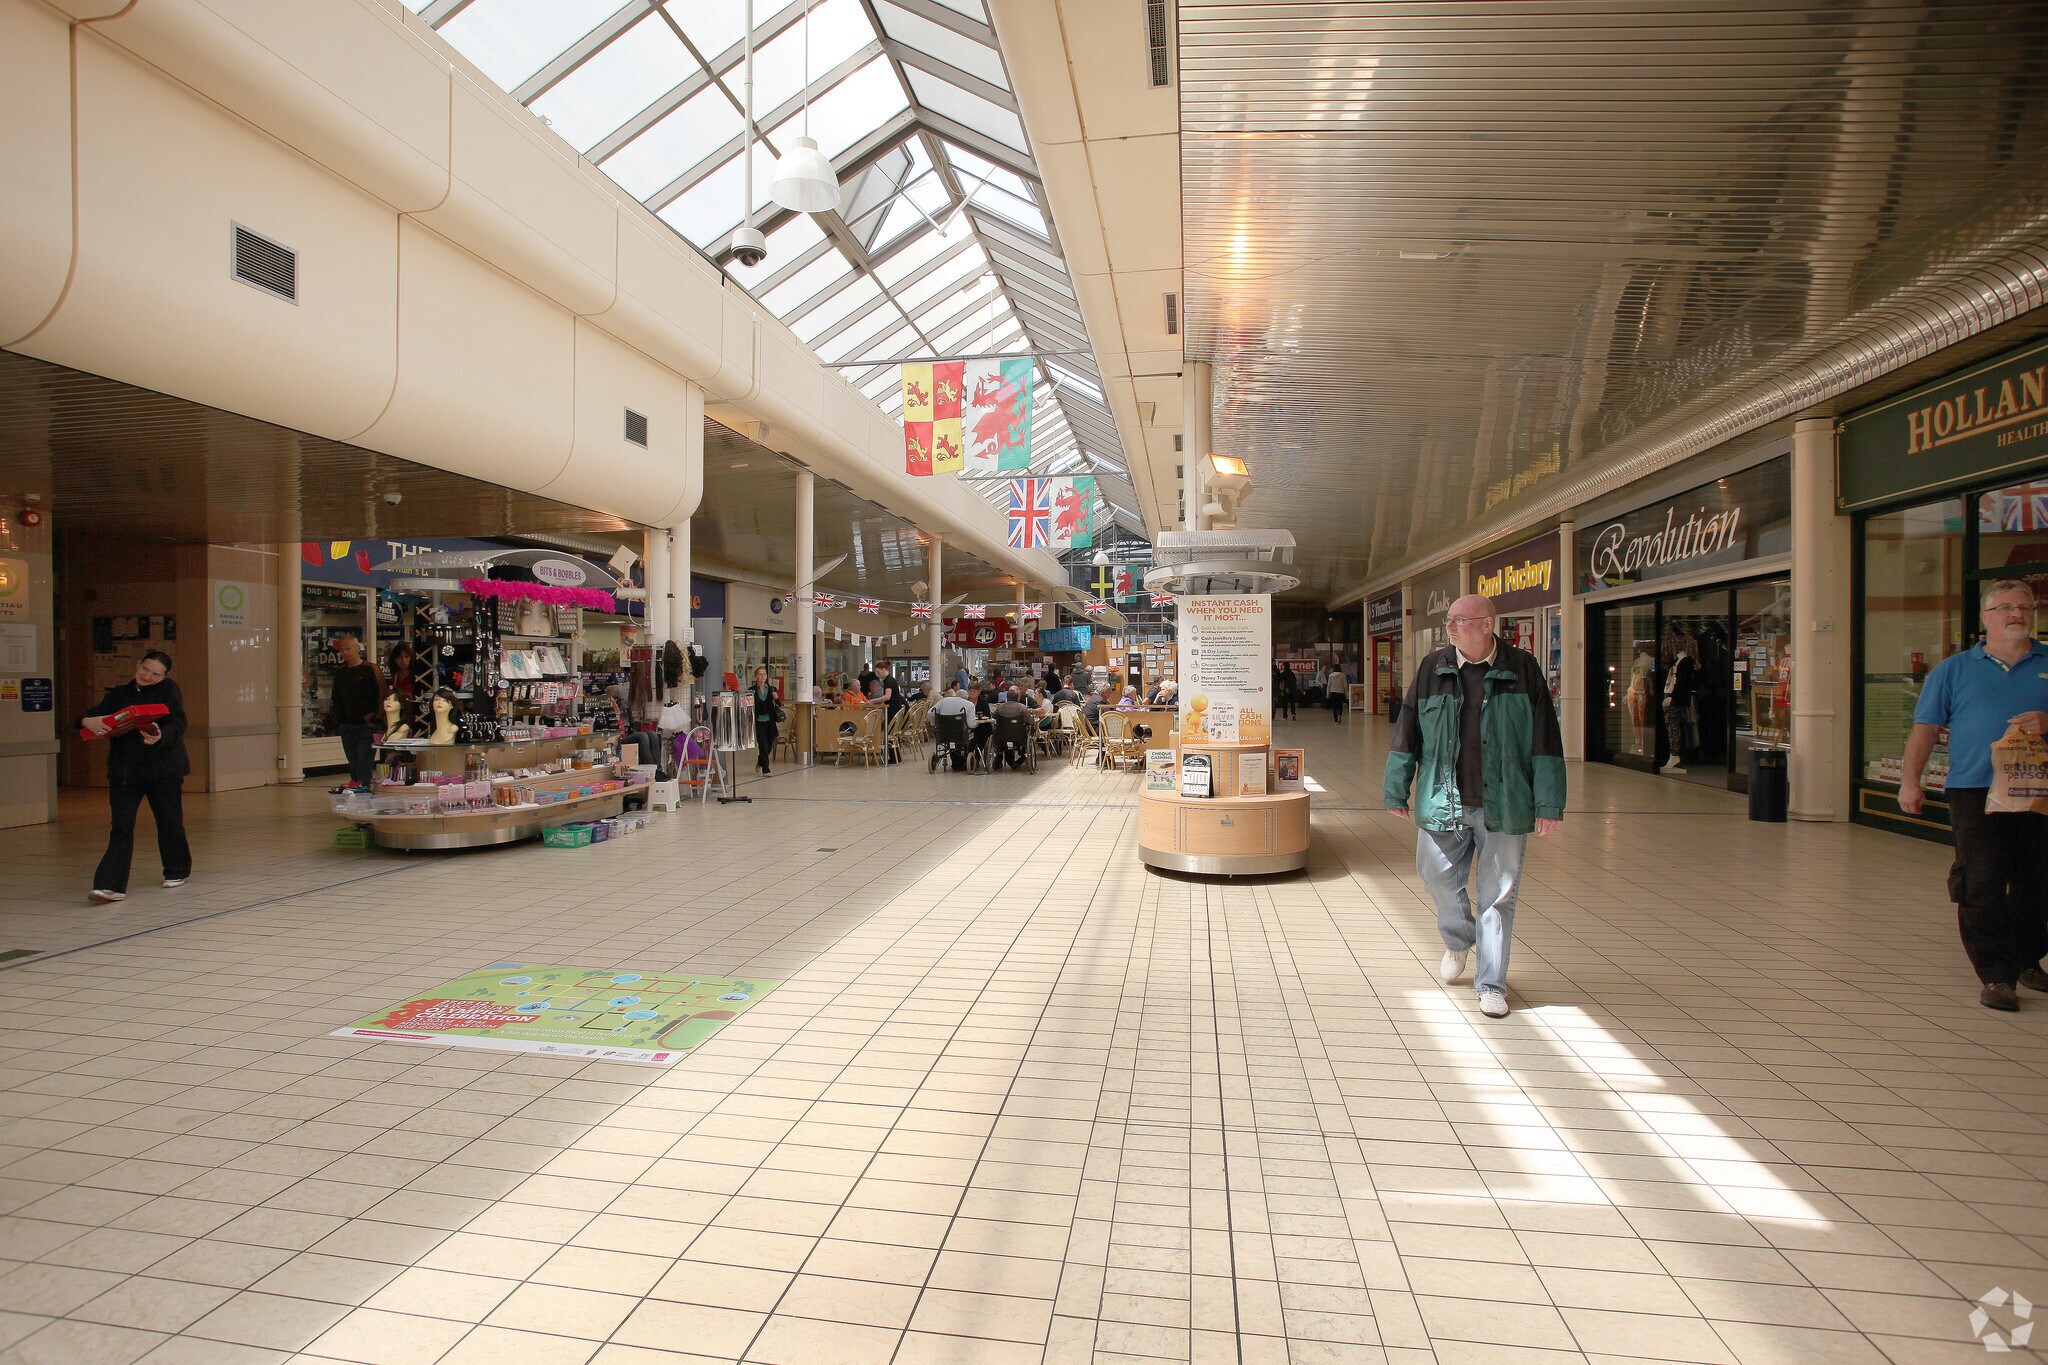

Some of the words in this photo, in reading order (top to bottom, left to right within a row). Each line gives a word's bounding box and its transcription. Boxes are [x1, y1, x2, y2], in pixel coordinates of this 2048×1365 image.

[1908, 365, 2048, 455] HOLLAN
[1591, 506, 1741, 579] Revolution
[540, 565, 553, 577] BITS
[558, 569, 582, 581] BOBBLES
[1477, 569, 1502, 598] Card
[1504, 559, 1552, 593] Factory
[342, 590, 356, 599] DAD
[1233, 599, 1258, 607] CASH
[1239, 606, 1264, 614] NEED
[1427, 590, 1450, 616] Clarks
[976, 628, 995, 641] 4u
[1518, 622, 1533, 654] DA
[1276, 660, 1316, 670] Inernet
[415, 1012, 535, 1022] CELEBRATION
